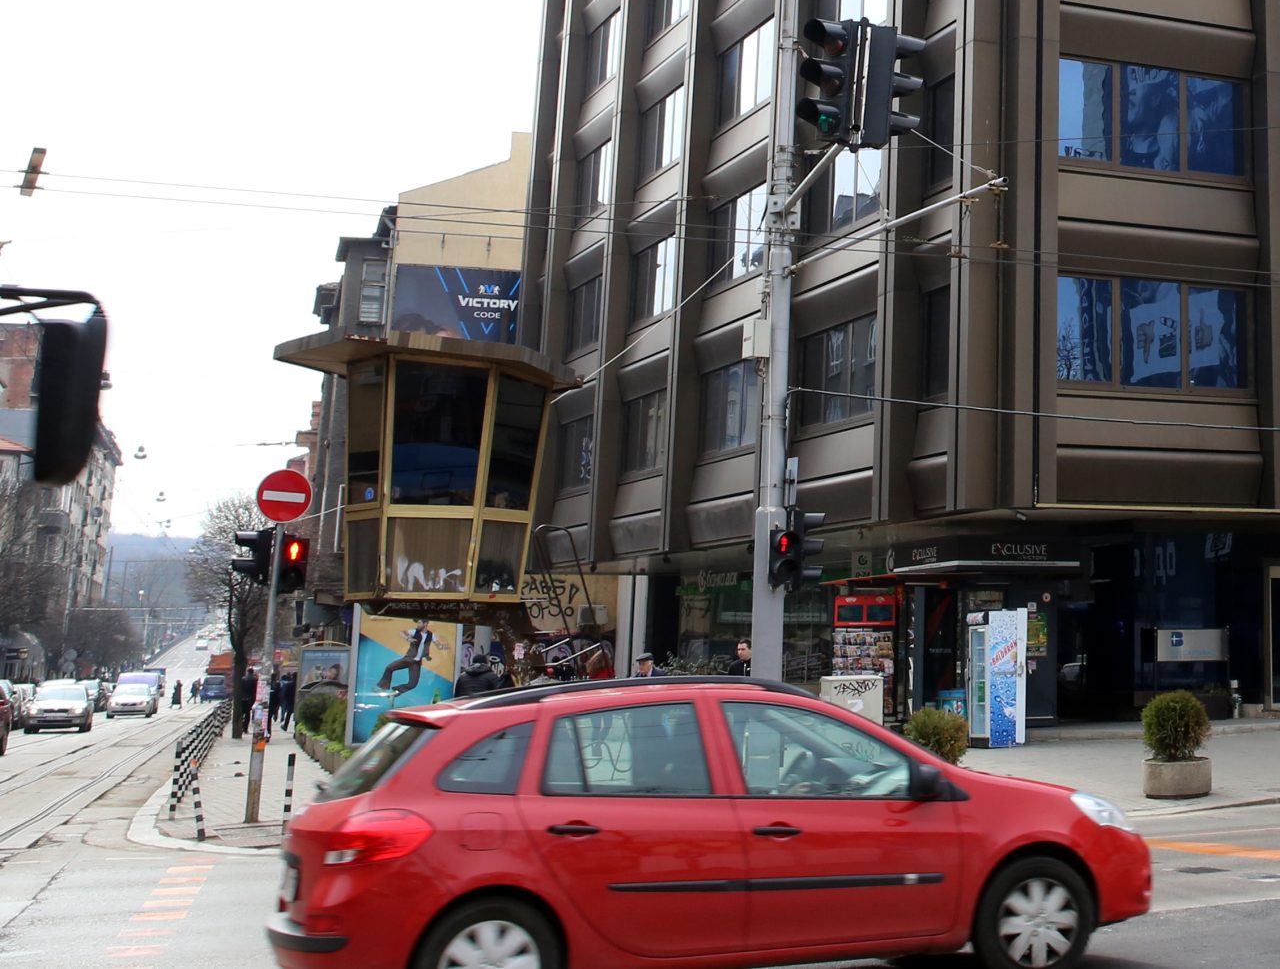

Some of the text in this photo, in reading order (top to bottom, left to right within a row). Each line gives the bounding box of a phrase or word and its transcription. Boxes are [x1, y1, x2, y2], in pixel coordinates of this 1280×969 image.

[457, 294, 519, 312] VICTORY
[473, 311, 501, 319] CODE
[912, 546, 937, 561] EXCLUSIVE
[991, 543, 1048, 556] EXCLUSIVE
